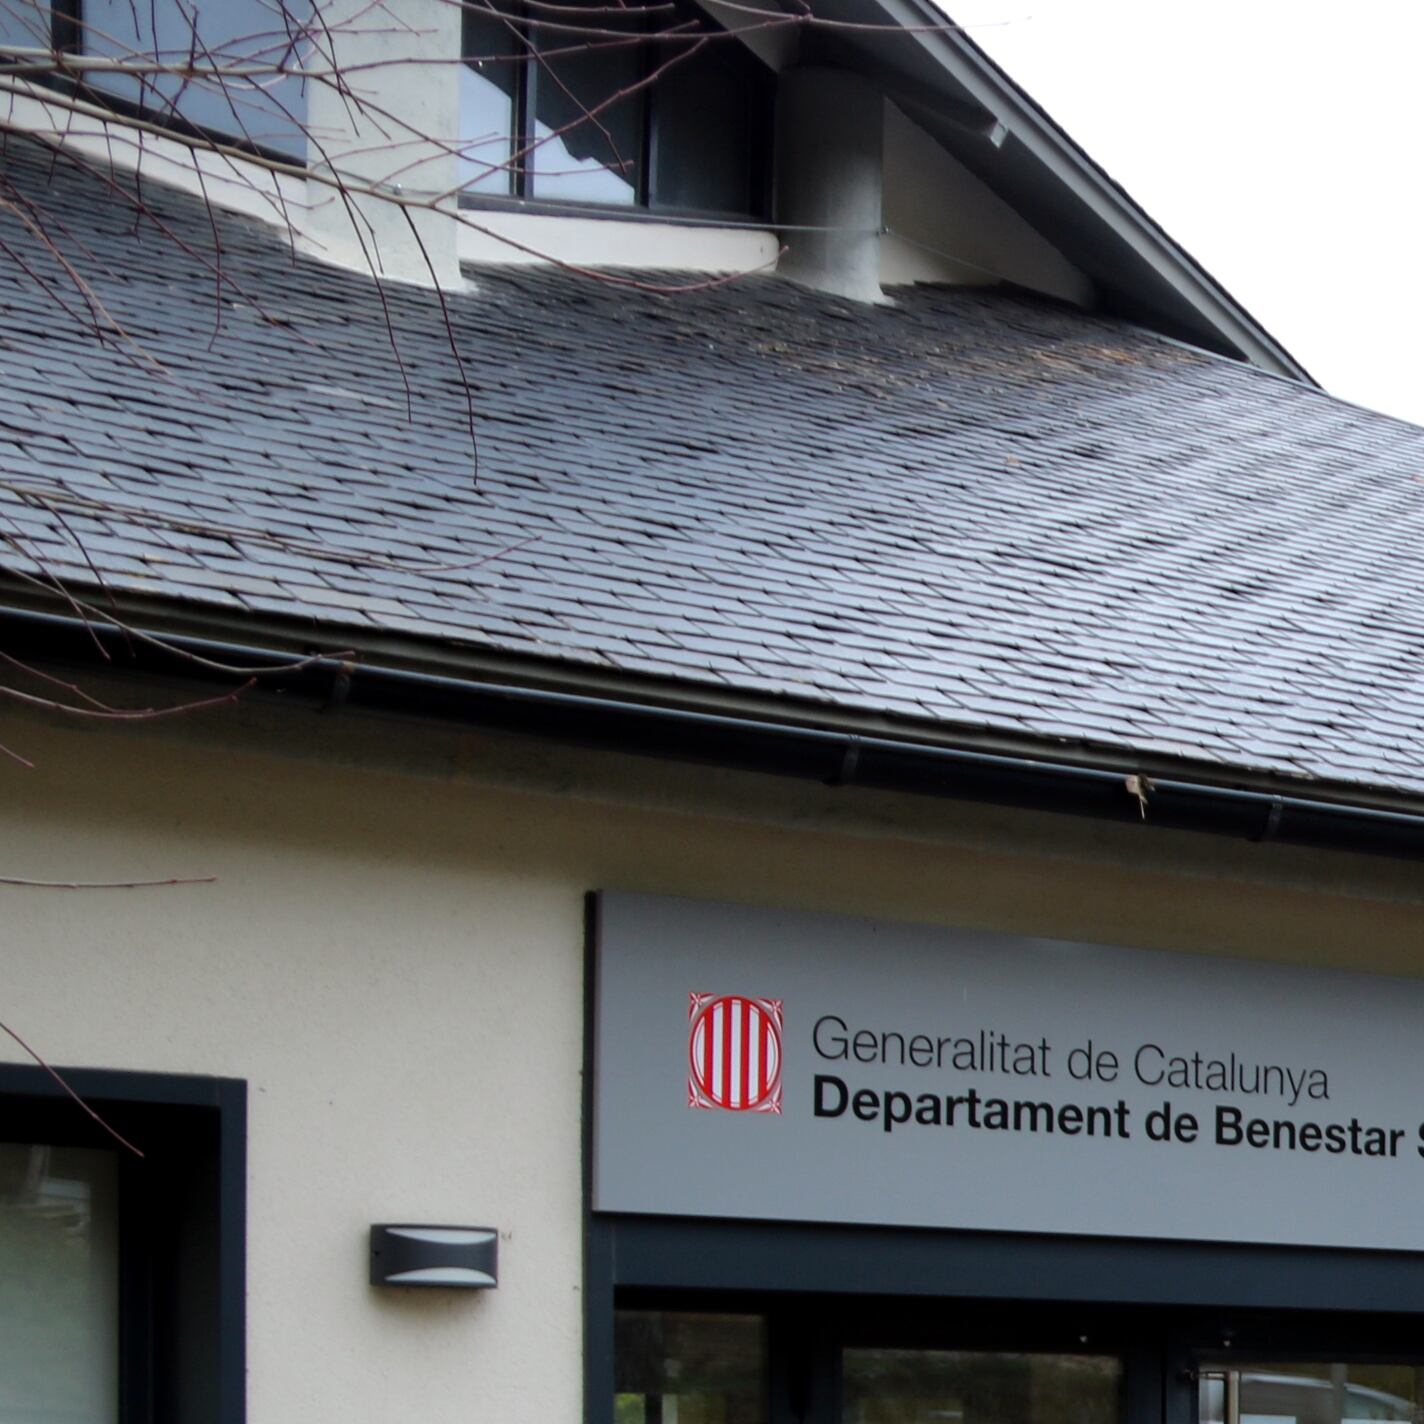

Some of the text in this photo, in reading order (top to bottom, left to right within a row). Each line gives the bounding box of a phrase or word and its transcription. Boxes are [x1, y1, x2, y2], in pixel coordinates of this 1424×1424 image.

[812, 1015, 1330, 1106] Generalitat de Catalunya
[813, 1074, 1130, 1139] Departament
[1145, 1101, 1199, 1143] de
[1215, 1105, 1405, 1157] Benestar
